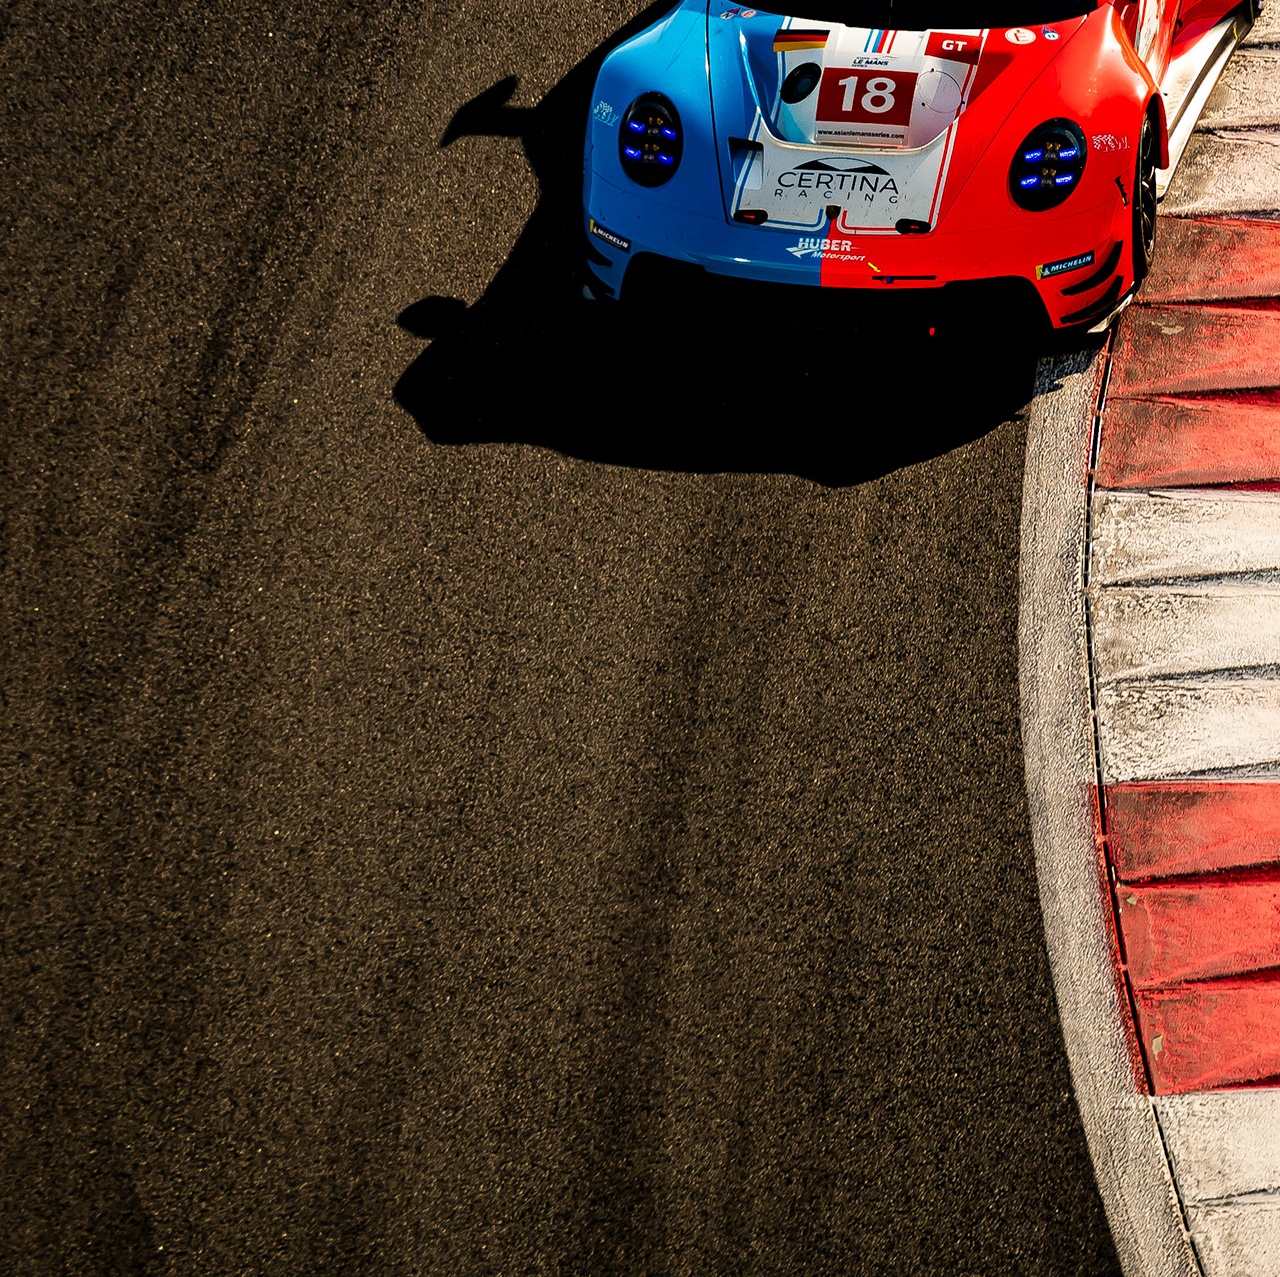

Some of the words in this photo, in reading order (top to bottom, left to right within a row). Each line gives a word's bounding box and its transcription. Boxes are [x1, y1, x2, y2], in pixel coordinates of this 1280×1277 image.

[941, 39, 968, 52] GT
[838, 76, 897, 114] 18
[817, 129, 905, 140] www.asianlemansseries.com
[778, 171, 899, 195] CERTINA
[774, 188, 898, 204] RACING
[597, 228, 629, 249] MICHELIN
[797, 237, 853, 252] HUBER
[810, 250, 866, 262] Motorsport
[1050, 254, 1092, 273] MICHELIN
